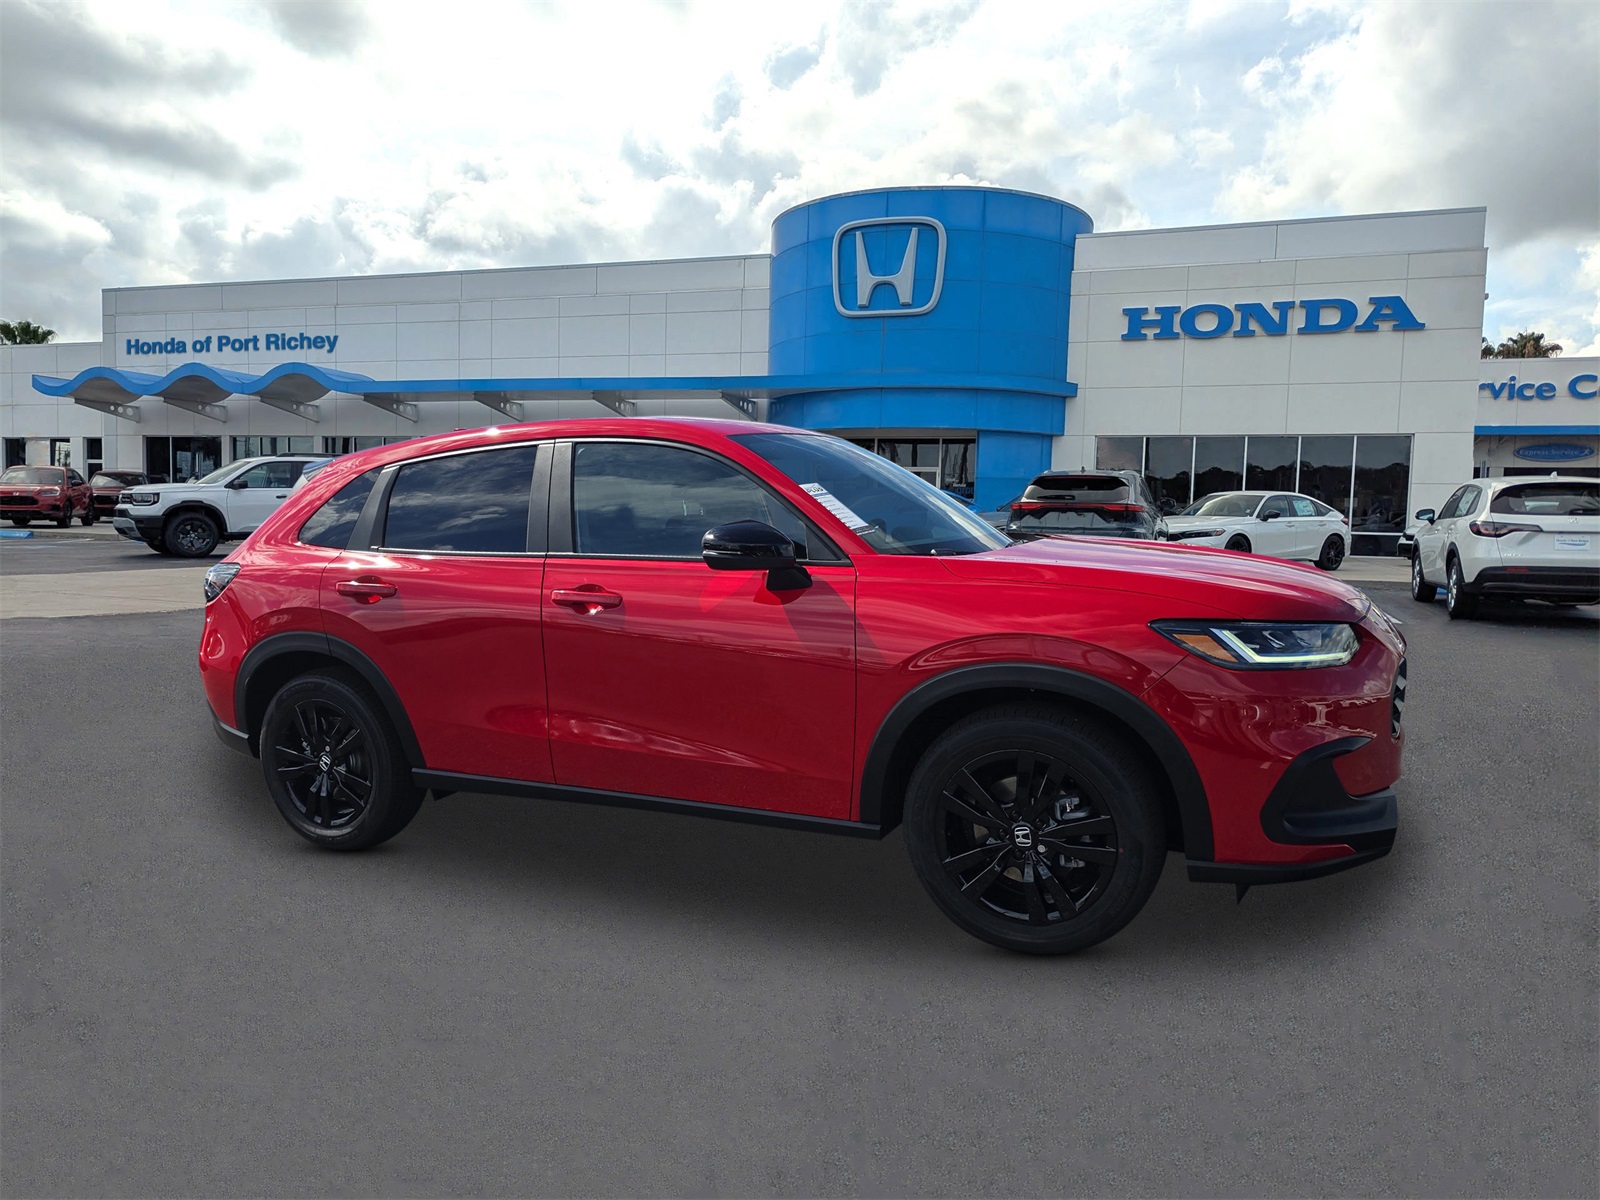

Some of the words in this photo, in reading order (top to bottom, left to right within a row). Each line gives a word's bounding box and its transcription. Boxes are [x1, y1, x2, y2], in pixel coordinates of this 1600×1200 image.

[1121, 295, 1426, 340] HONDA
[126, 338, 187, 355] Honda
[192, 336, 212, 353] of
[217, 335, 260, 352] Port
[265, 333, 339, 354] Richey
[1568, 374, 1600, 400] C
